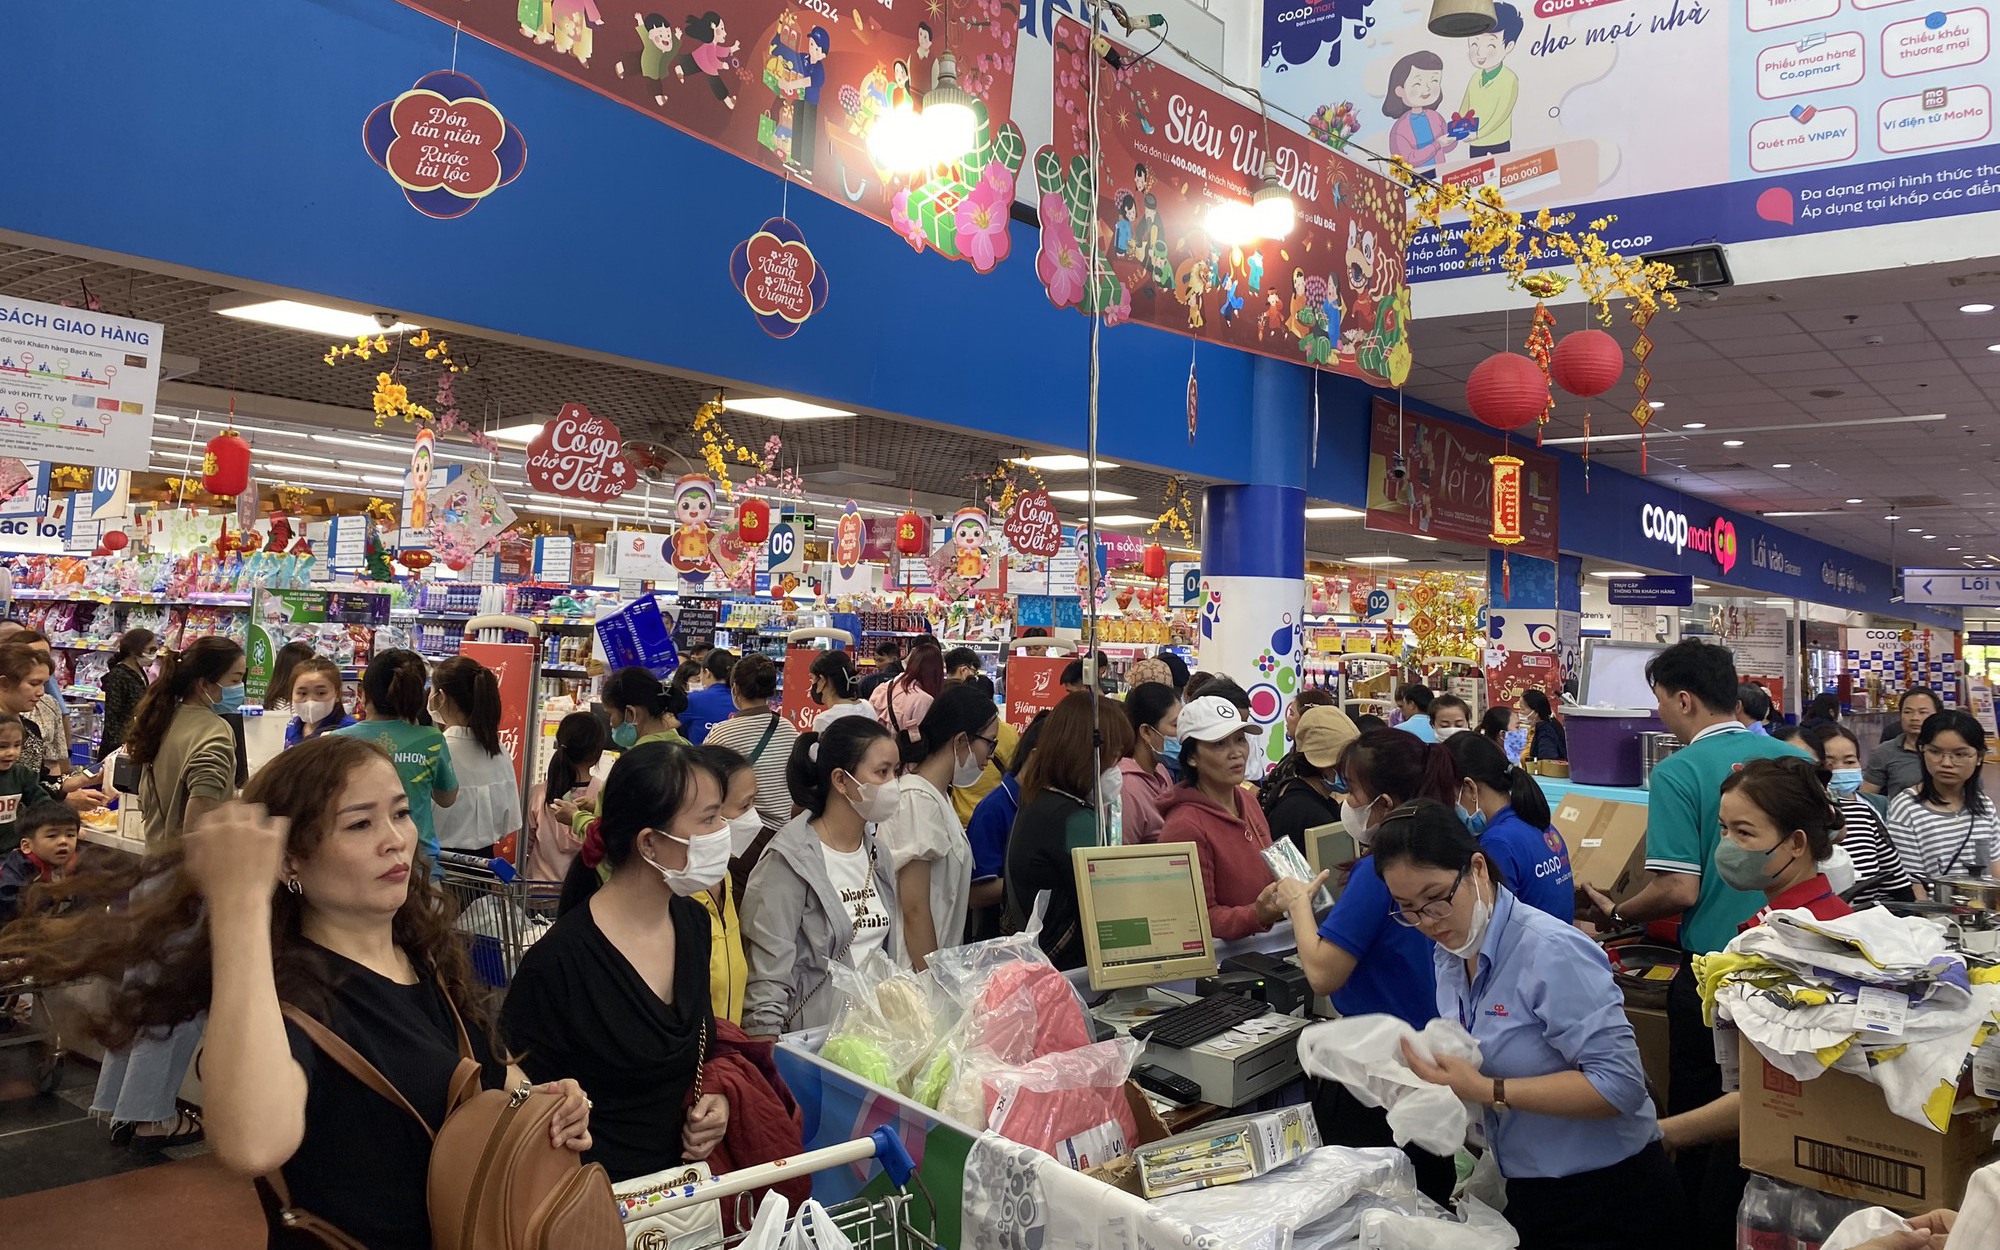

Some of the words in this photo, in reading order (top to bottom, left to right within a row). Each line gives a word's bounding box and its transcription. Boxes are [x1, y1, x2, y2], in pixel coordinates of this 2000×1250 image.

[1530, 24, 1577, 57] cho
[1585, 12, 1642, 44] mọi
[1650, 0, 1711, 34] nhà
[1900, 31, 1936, 47] Chiếu
[1938, 26, 1970, 40] khấu
[1900, 44, 1944, 59] thương
[1946, 38, 1970, 51] mại
[1764, 55, 1796, 72] Phiếu
[1798, 55, 1824, 66] mua
[1826, 48, 1857, 64] hàng
[1779, 63, 1841, 81] Co.opmart
[429, 107, 469, 128] Đón
[1884, 120, 1896, 130] Ví
[1898, 117, 1925, 129] điện
[1944, 108, 1984, 121] MoMo
[411, 121, 441, 139] tân
[443, 129, 483, 146] niên
[1756, 138, 1784, 150] Quét
[1787, 134, 1805, 146] mã
[1808, 128, 1848, 142] VNPAY
[420, 144, 470, 167] Rước
[1134, 139, 1149, 152] Hoá
[1148, 145, 1163, 160] đơn
[1164, 94, 1225, 160] Siêu
[1229, 124, 1267, 180] Ưu
[1276, 146, 1320, 202] Đãi
[415, 158, 440, 178] tài
[442, 164, 471, 184] lộc
[1501, 166, 1538, 186] 500.000
[1801, 190, 1822, 201] Đa
[1826, 184, 1864, 198] dạng
[1867, 177, 1896, 192] mọi
[1899, 172, 1933, 188] hình
[1936, 168, 1973, 182] thức
[1801, 204, 1822, 220] Áp
[1825, 202, 1863, 216] dụng
[1866, 196, 1886, 211] tại
[1889, 190, 1929, 206] khắp
[1932, 184, 1963, 200] các
[1414, 233, 1429, 245] CÁ
[1612, 235, 1653, 250] CO.OP
[780, 252, 799, 269] An
[1412, 248, 1434, 260] hấp
[1436, 246, 1458, 258] dẫn
[758, 256, 802, 284] Khang
[1416, 264, 1436, 275] hơn
[1439, 260, 1465, 272] 1000
[774, 276, 805, 297] Thịnh
[758, 284, 802, 312] Vượng
[0, 308, 47, 328] SÁCH
[52, 318, 96, 336] GIAO
[101, 326, 150, 346] HÀNG
[27, 340, 50, 350] Khách
[50, 344, 69, 354] hàng
[70, 346, 88, 356] Bạch
[88, 350, 102, 358] Kim
[580, 418, 604, 436] đến
[552, 420, 620, 468] Co.op
[97, 467, 117, 492] 08
[552, 455, 609, 494] Tết
[604, 480, 627, 496] về
[36, 494, 46, 512] 06
[1034, 494, 1048, 508] đến
[1018, 498, 1056, 533] Co.op
[772, 532, 794, 554] 06
[1018, 523, 1049, 551] Tết
[1045, 540, 1056, 552] về
[1752, 534, 1766, 568] Lối
[1768, 543, 1784, 572] vào
[1370, 598, 1388, 609] 02
[691, 626, 697, 634] 7
[1878, 642, 1899, 650] QUY
[1014, 700, 1036, 714] Hôm
